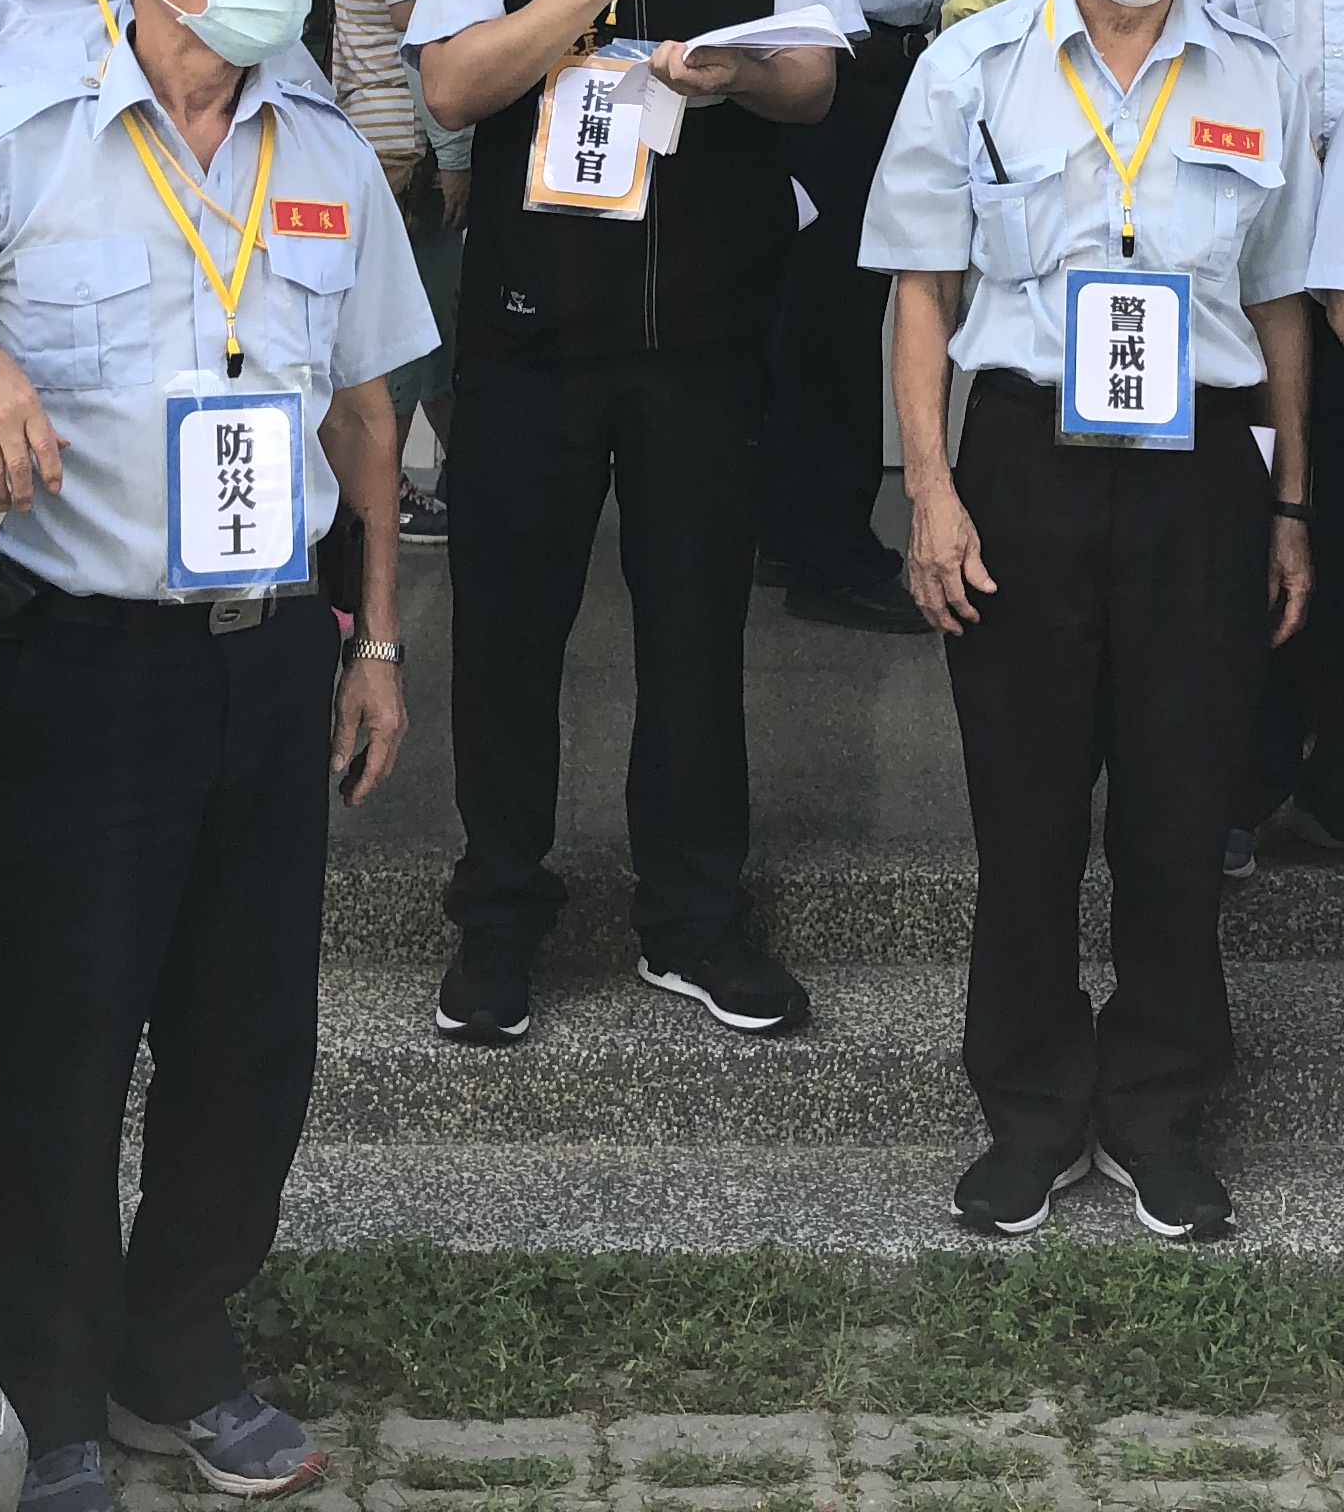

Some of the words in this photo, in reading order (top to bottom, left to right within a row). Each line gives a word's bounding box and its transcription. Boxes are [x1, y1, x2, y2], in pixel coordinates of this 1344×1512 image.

[574, 79, 615, 184] 指揮官
[1107, 295, 1147, 411] 警戒組
[216, 423, 257, 557] 防災士
